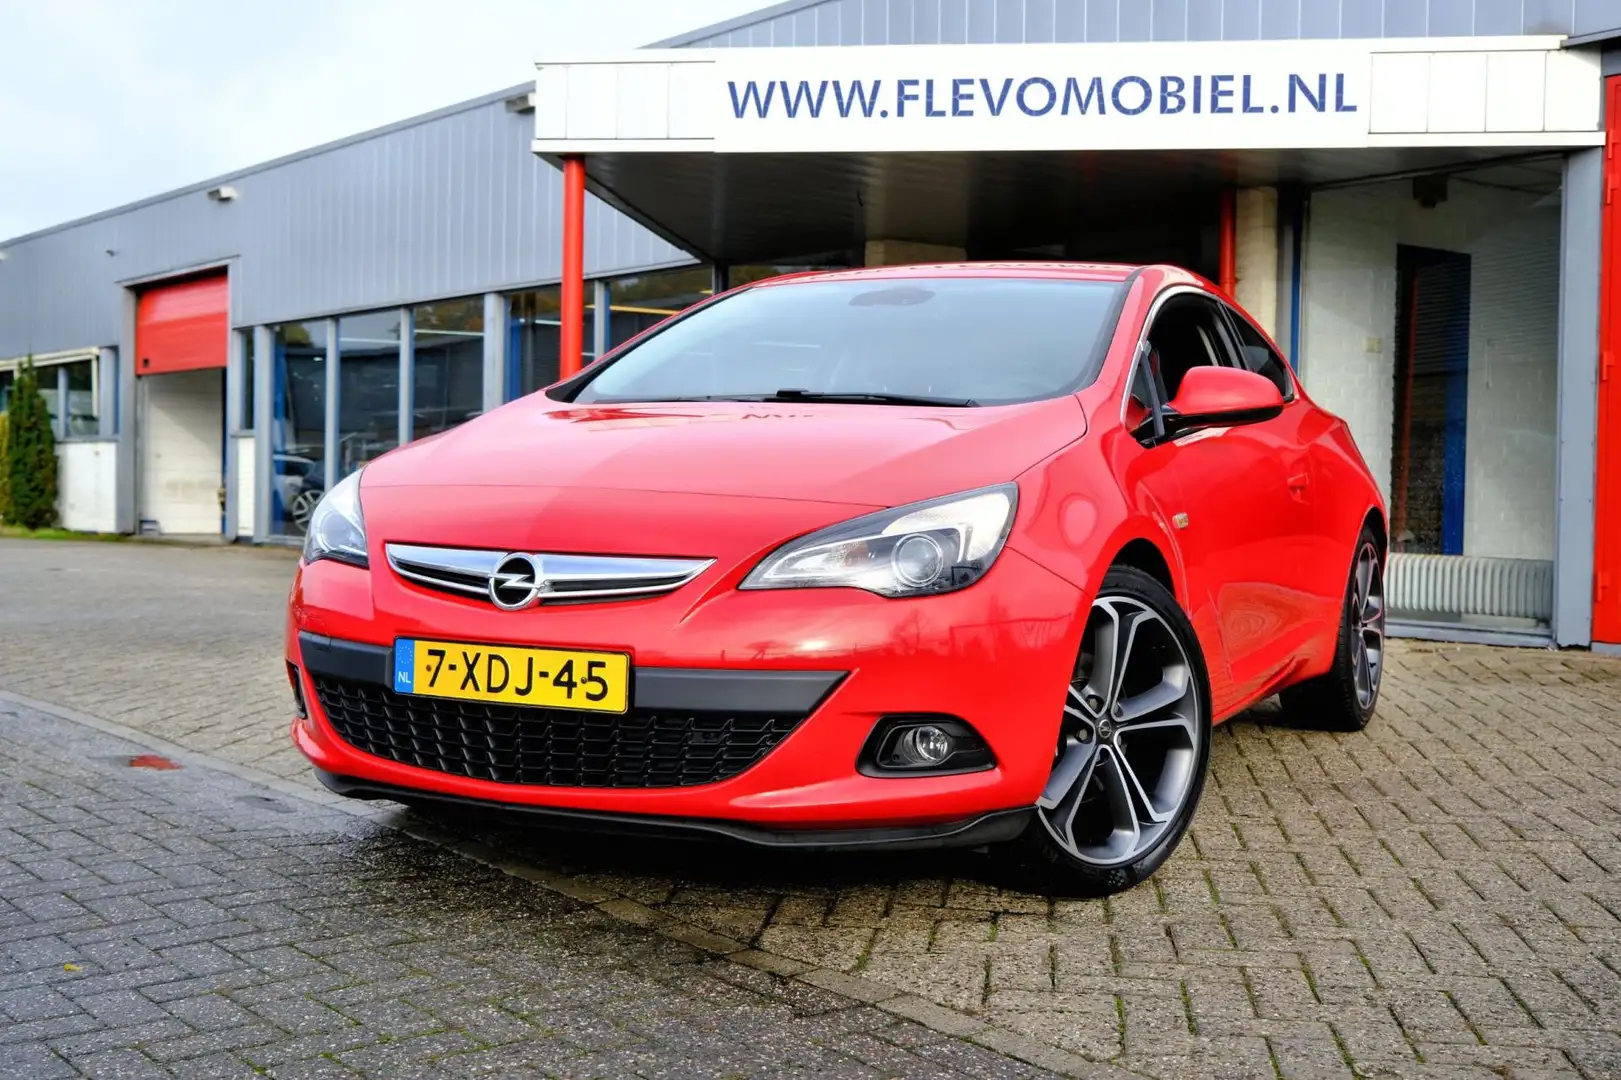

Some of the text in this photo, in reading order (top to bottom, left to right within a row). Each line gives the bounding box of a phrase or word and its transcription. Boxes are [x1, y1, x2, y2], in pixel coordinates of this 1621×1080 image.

[727, 72, 1357, 119] WWW.FLEVOMOBIEL.NL
[398, 671, 411, 683] NL
[427, 649, 609, 702] 7-XDJ-45
